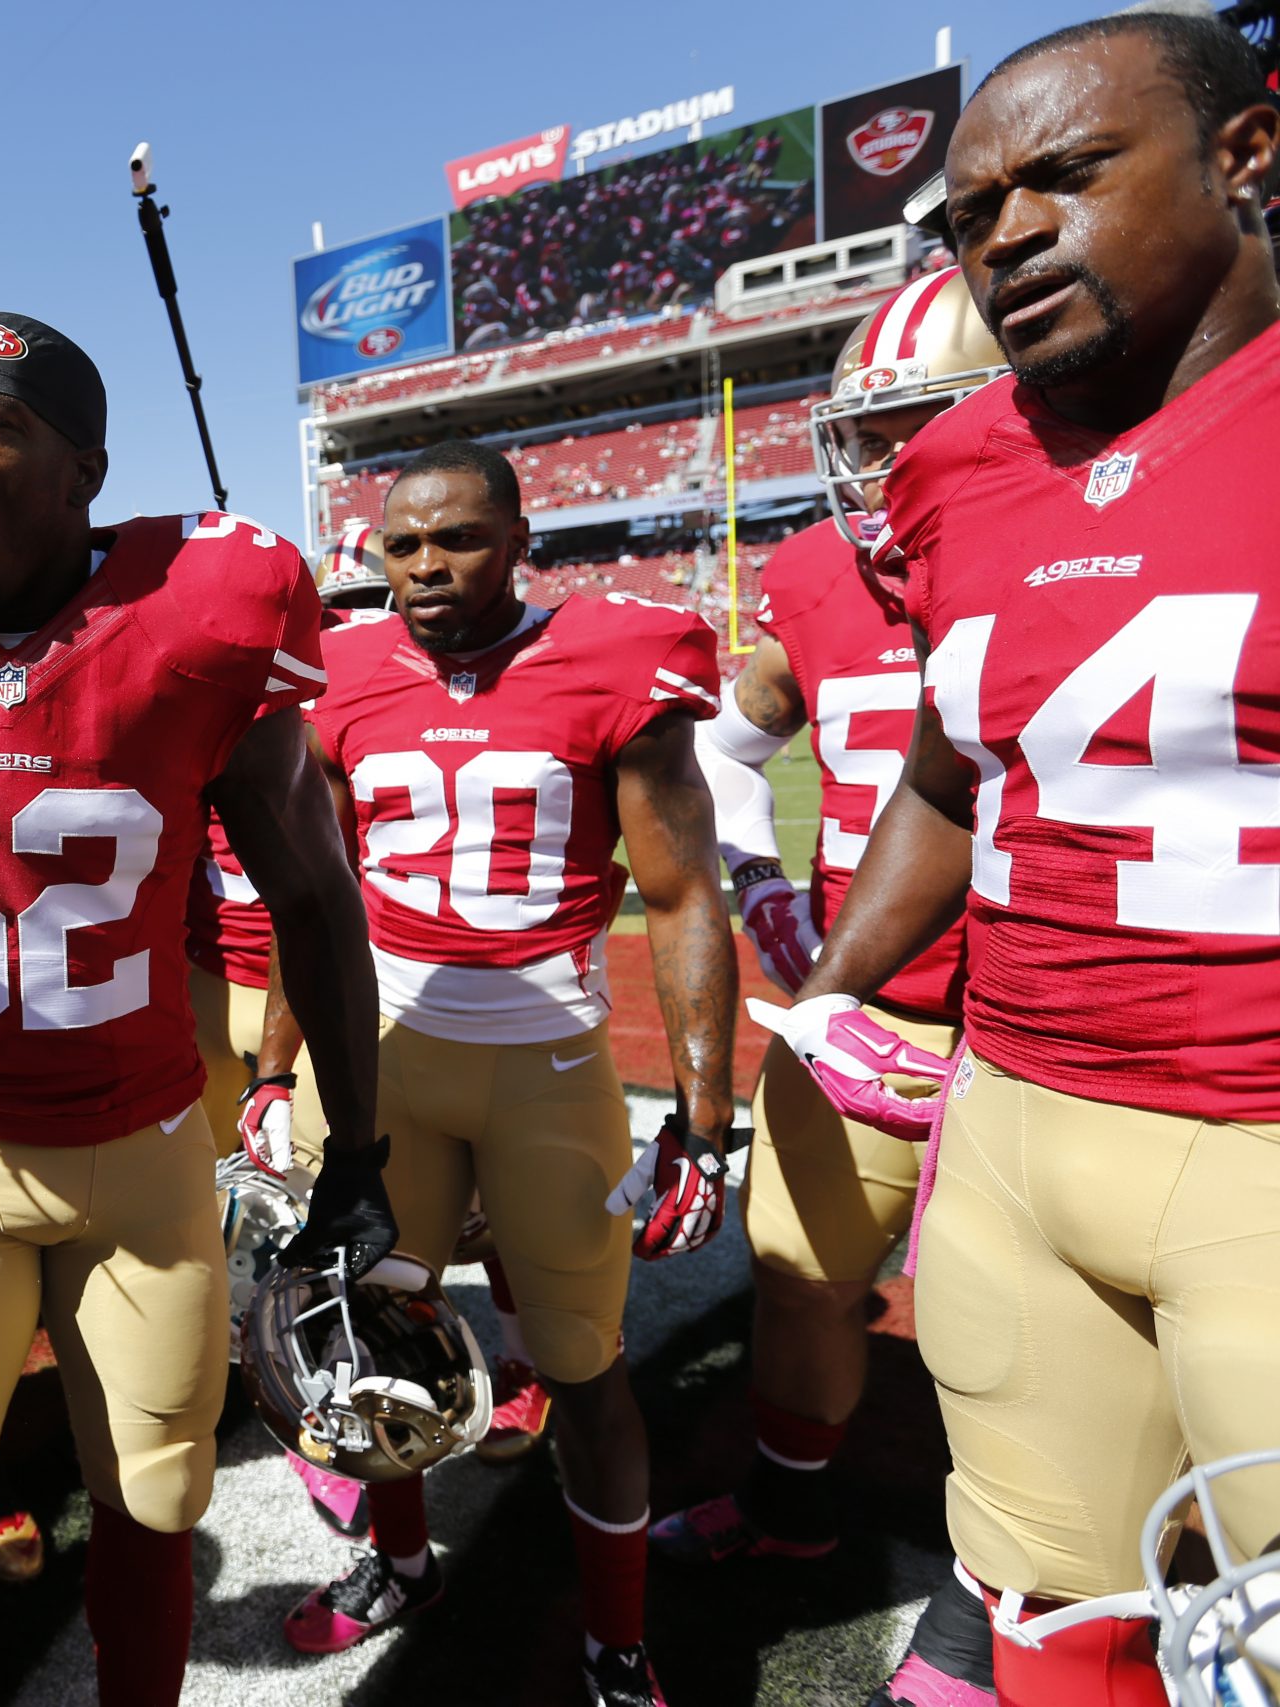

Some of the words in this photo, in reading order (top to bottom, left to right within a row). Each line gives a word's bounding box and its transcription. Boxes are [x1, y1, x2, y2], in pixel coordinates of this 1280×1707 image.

[572, 85, 734, 160] STADIUM
[338, 262, 424, 301] BUD
[322, 279, 436, 323] LIGHT
[1091, 475, 1121, 497] NFL
[1023, 555, 1143, 588] 49ERS
[878, 648, 917, 664] 49E
[453, 683, 471, 695] NFL
[421, 728, 490, 743] 49ERS
[922, 593, 1279, 935] 14
[350, 750, 573, 930] 20
